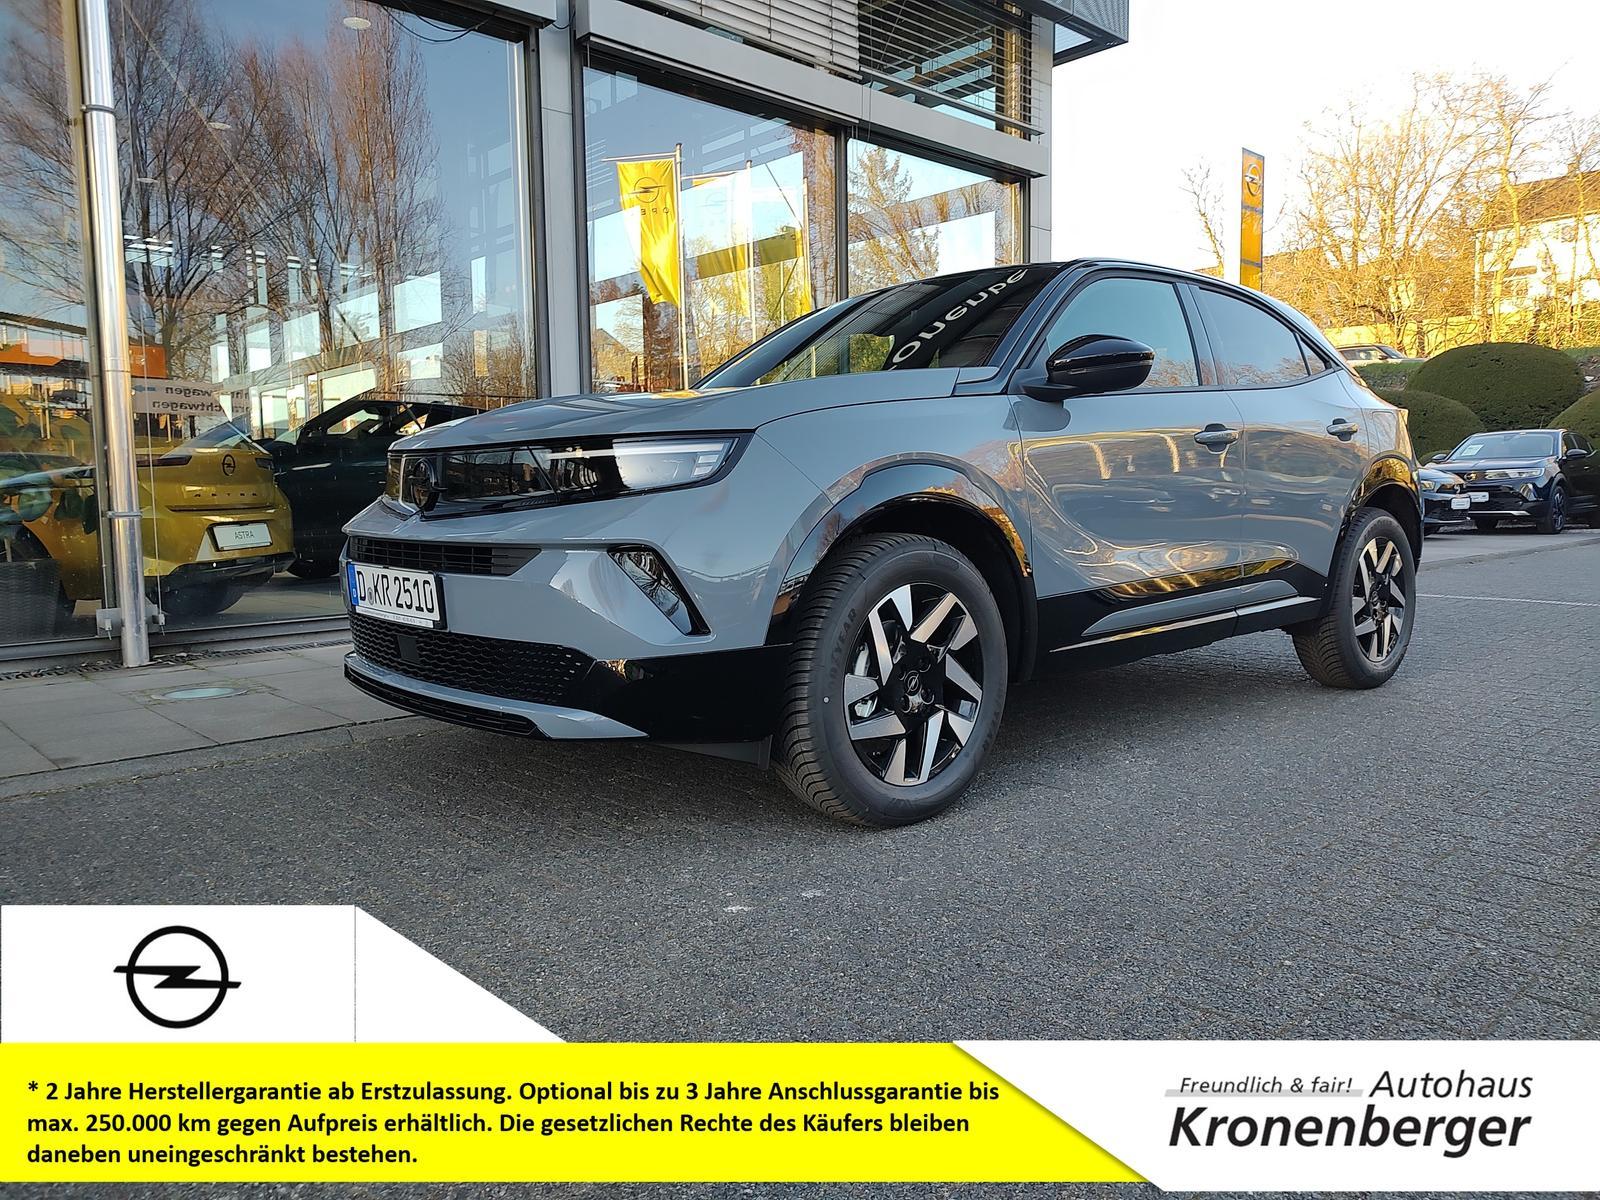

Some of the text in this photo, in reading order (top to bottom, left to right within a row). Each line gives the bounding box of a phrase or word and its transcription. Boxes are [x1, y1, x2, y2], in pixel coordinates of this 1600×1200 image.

[234, 530, 255, 540] ASTRA
[356, 570, 435, 614] D KR 2510
